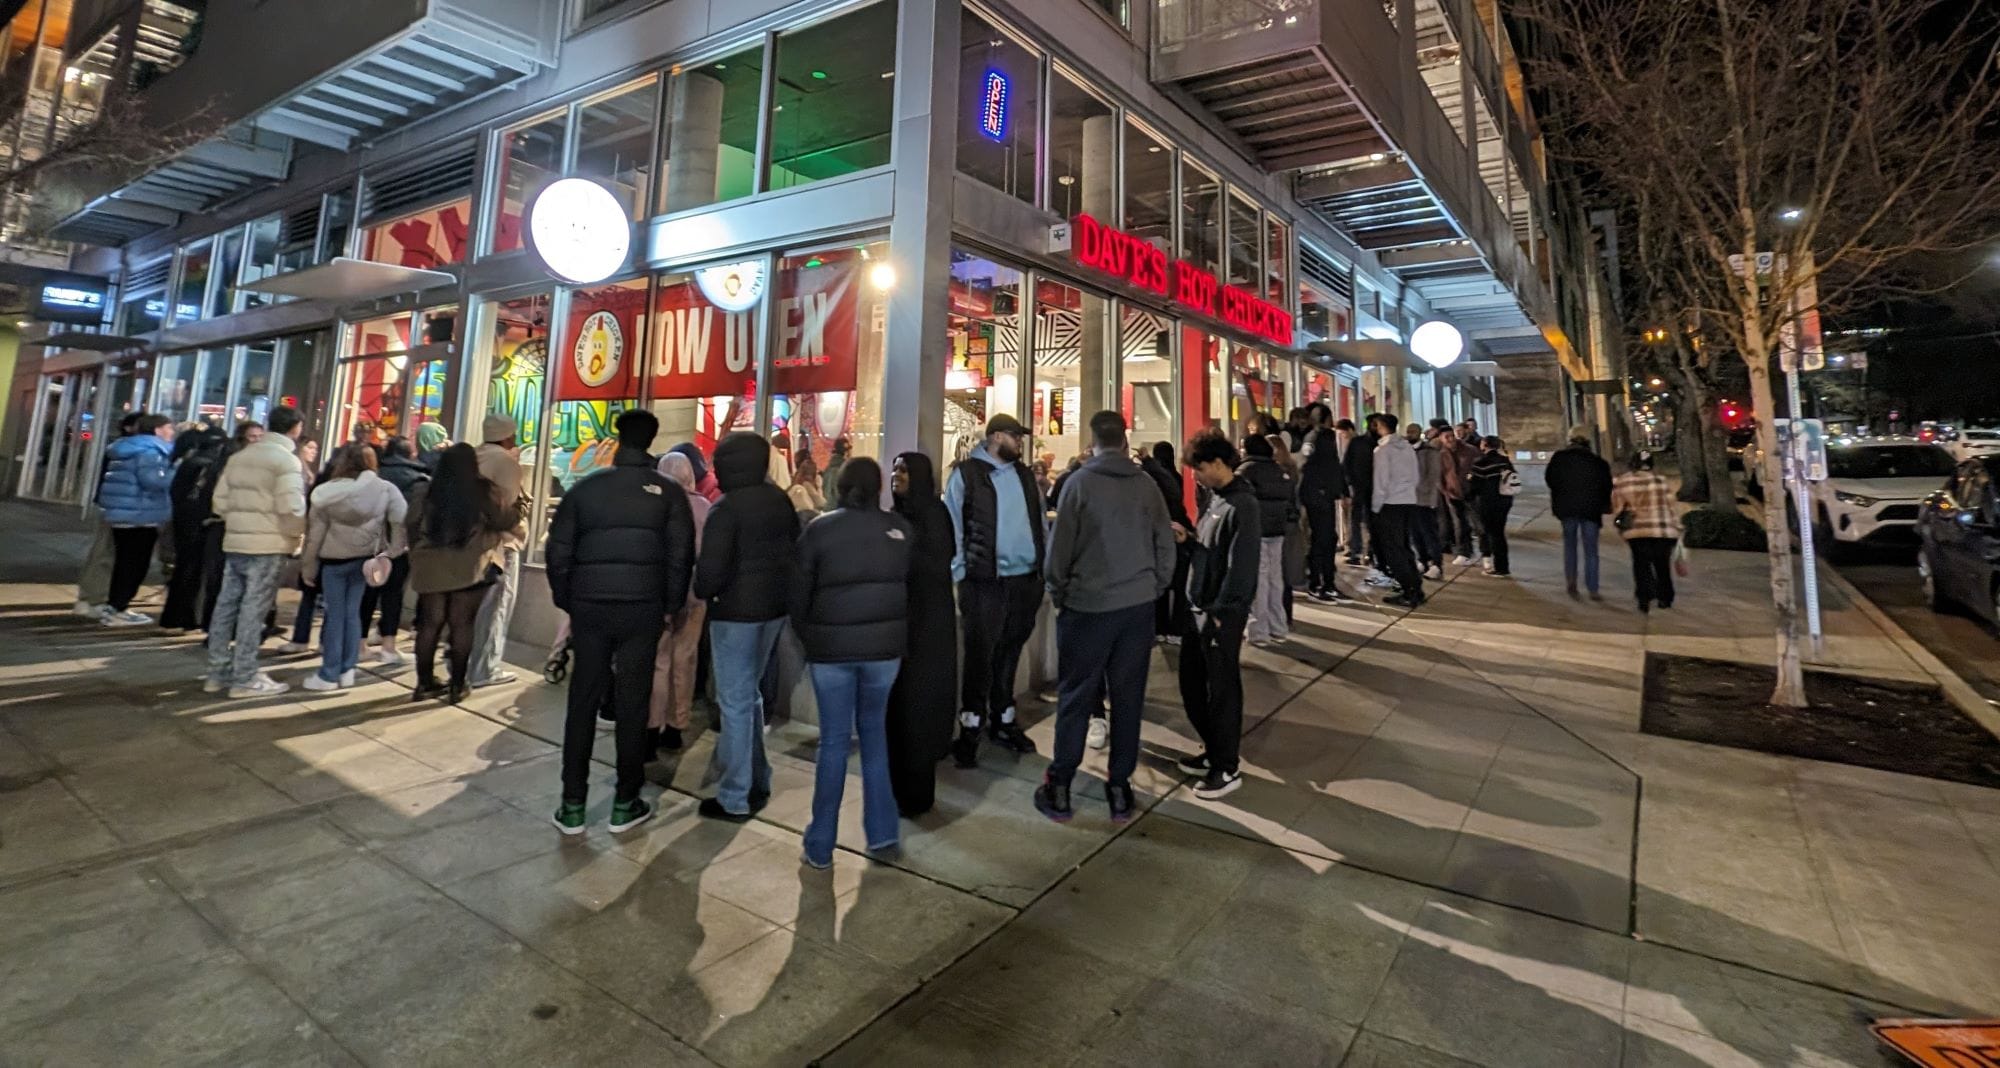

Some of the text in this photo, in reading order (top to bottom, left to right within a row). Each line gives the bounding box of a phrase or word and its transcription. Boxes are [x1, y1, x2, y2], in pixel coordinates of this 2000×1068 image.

[988, 78, 1001, 131] OPEN
[1079, 213, 1293, 347] DAVE'S HOT CHICKEN
[725, 292, 827, 373] OEN
